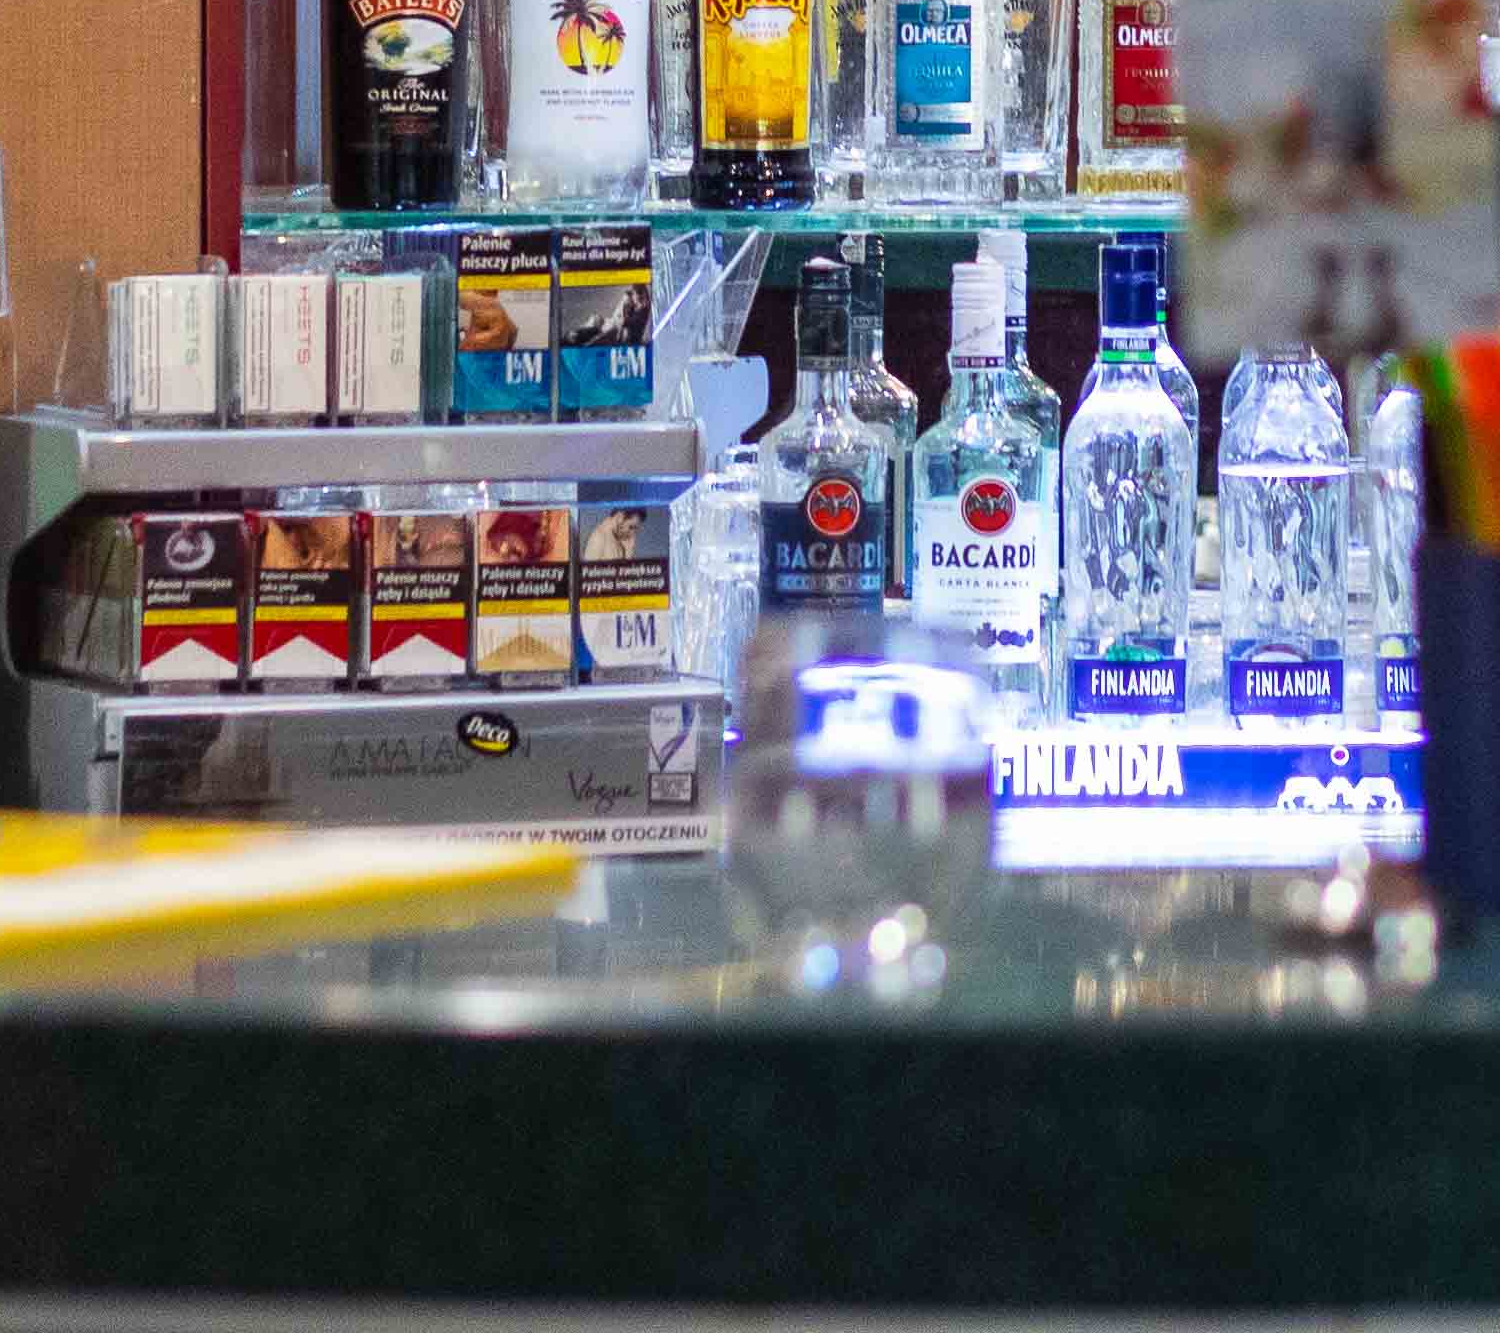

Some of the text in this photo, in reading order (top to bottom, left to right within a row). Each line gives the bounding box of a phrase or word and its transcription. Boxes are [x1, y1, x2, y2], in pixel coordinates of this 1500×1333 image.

[900, 23, 968, 45] OLMECA
[367, 88, 449, 102] ORIGINAL
[461, 236, 512, 252] Palenie
[461, 255, 509, 272] niszczy
[505, 351, 543, 385] L&M
[610, 346, 647, 381] L&M
[776, 536, 883, 568] BACARDÍ
[931, 536, 1036, 569] BACARDÍ
[1091, 668, 1176, 697] FINLANDIA
[1245, 669, 1331, 697] FINLANDIA
[994, 744, 1186, 798] FINLANDIA
[567, 769, 642, 813] Vogue
